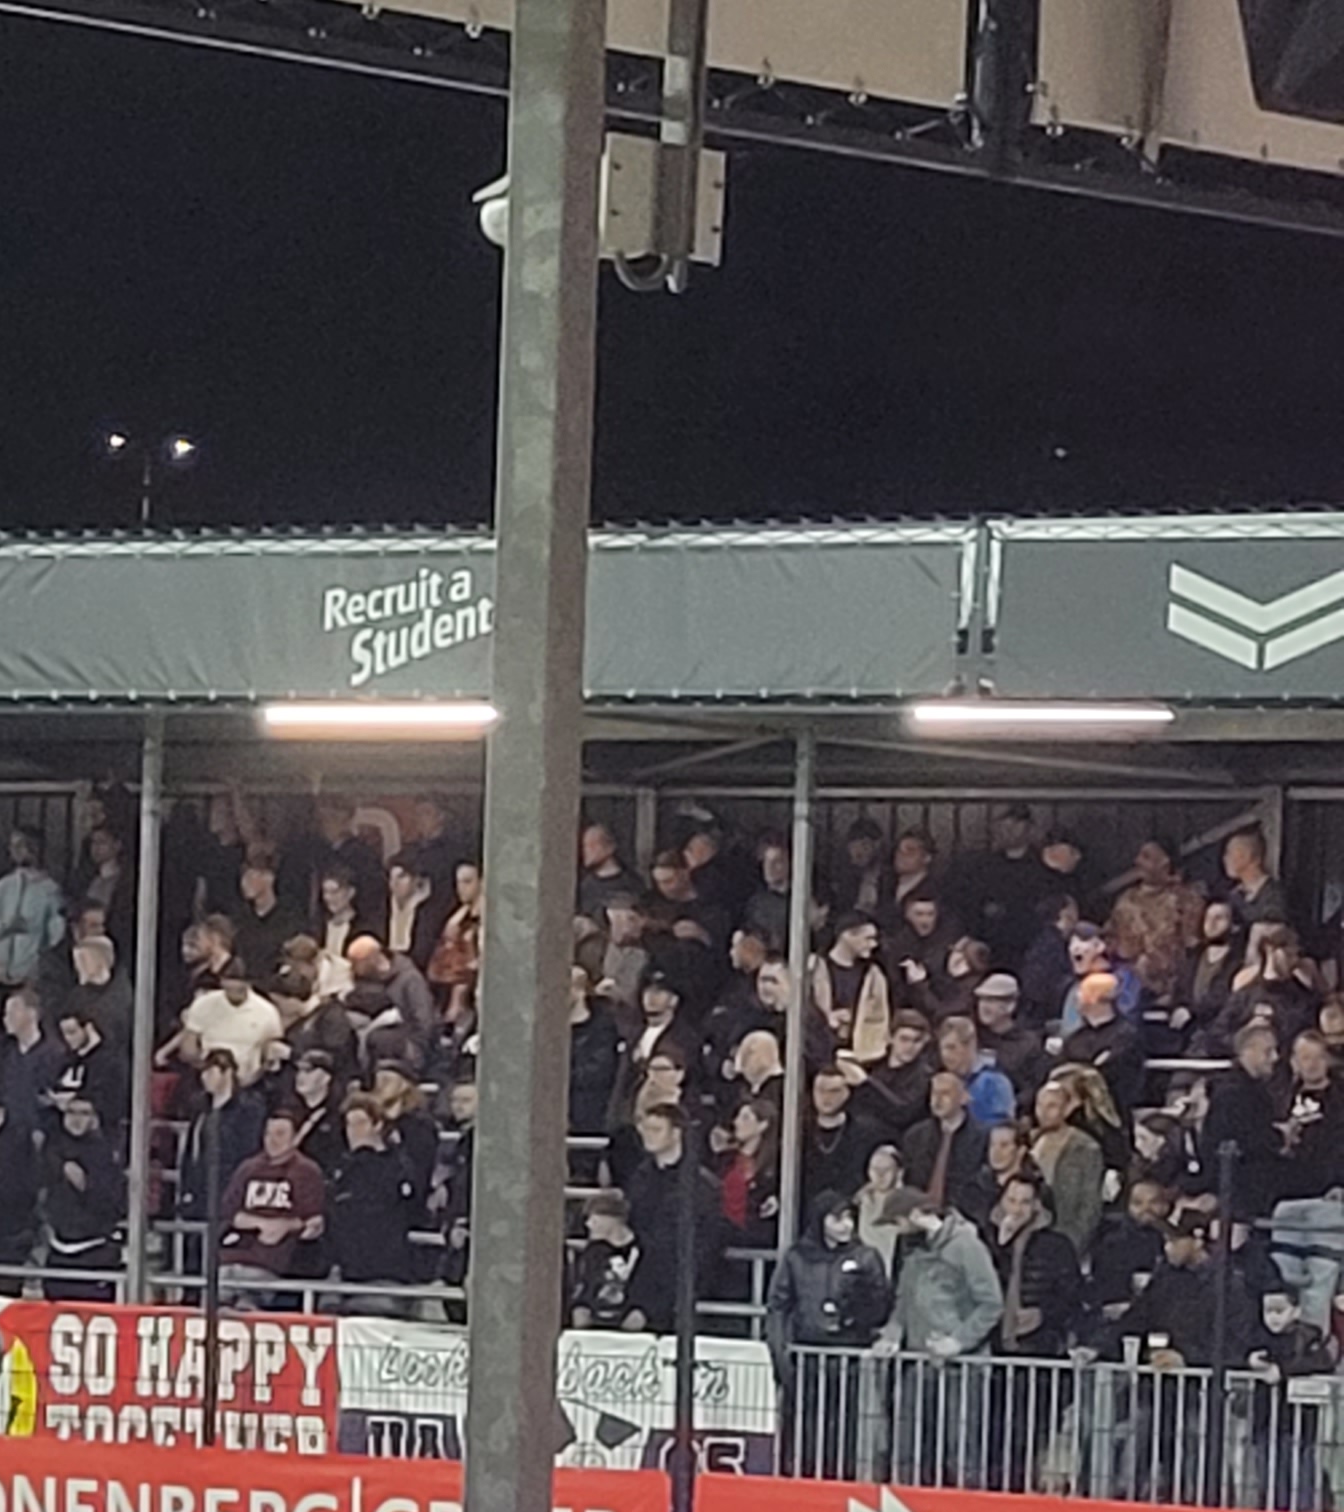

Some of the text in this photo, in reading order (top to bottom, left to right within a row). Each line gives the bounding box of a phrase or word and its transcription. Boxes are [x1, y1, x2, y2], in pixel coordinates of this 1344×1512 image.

[323, 568, 472, 632] Recruit a
[350, 597, 495, 687] Student
[49, 1313, 334, 1407] SO HAPPY
